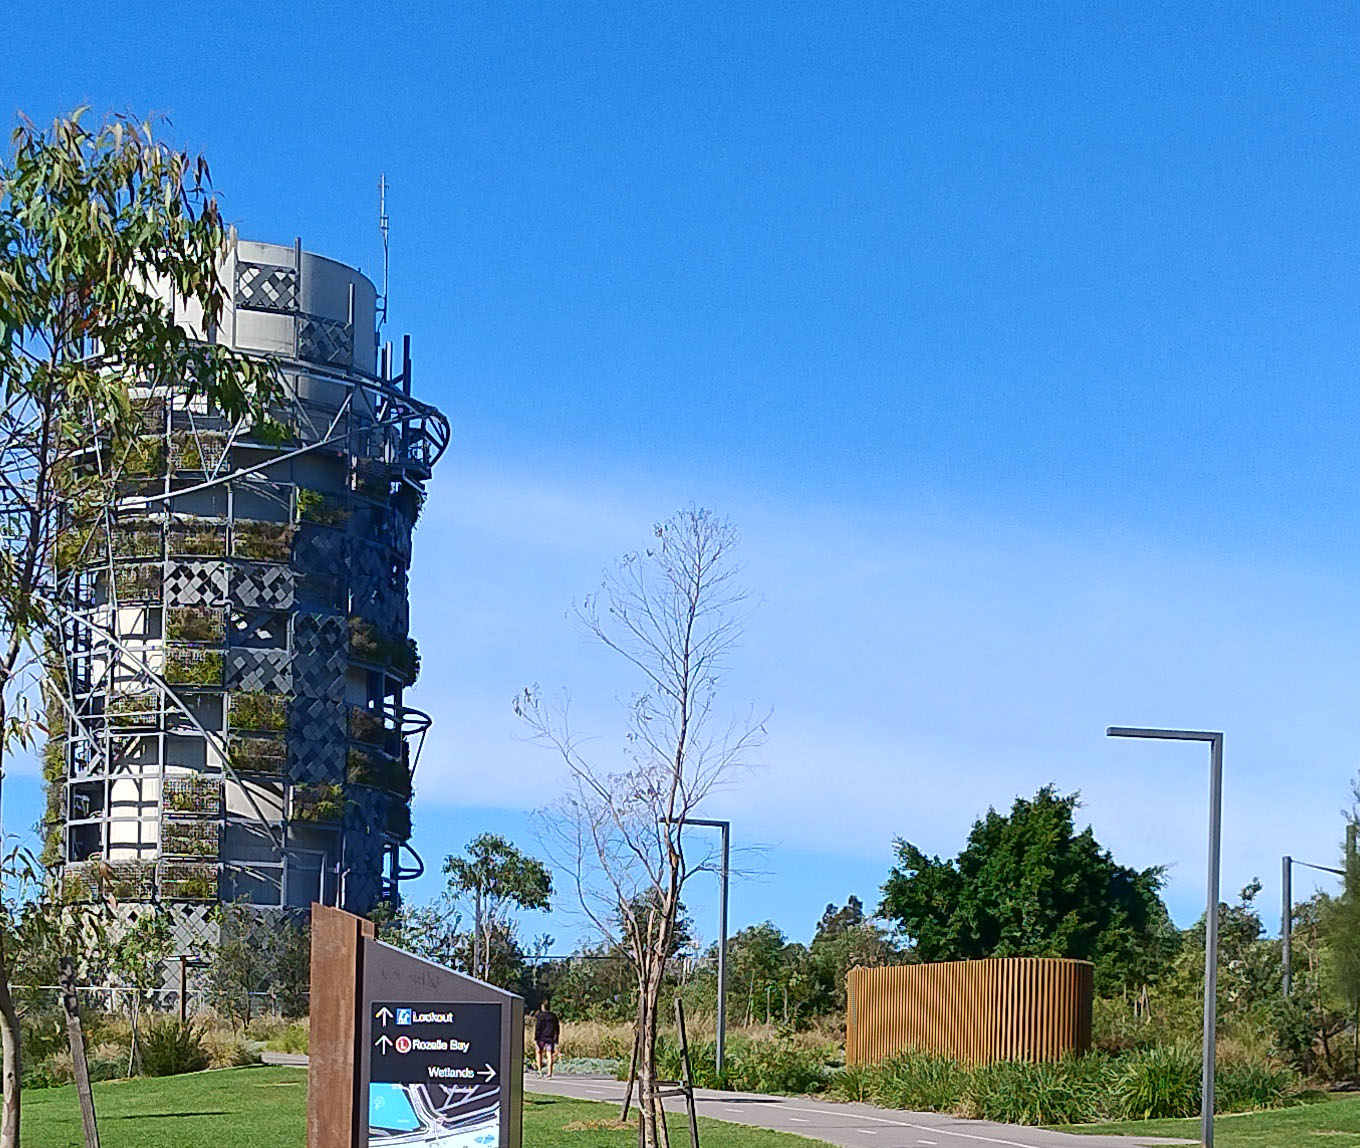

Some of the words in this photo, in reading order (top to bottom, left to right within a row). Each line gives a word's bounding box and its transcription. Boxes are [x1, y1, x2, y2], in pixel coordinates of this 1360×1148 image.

[412, 1011, 454, 1023] Lookout
[412, 1038, 448, 1050] Rozelle
[449, 1039, 470, 1054] Bay
[427, 1066, 475, 1078] Wetlands
